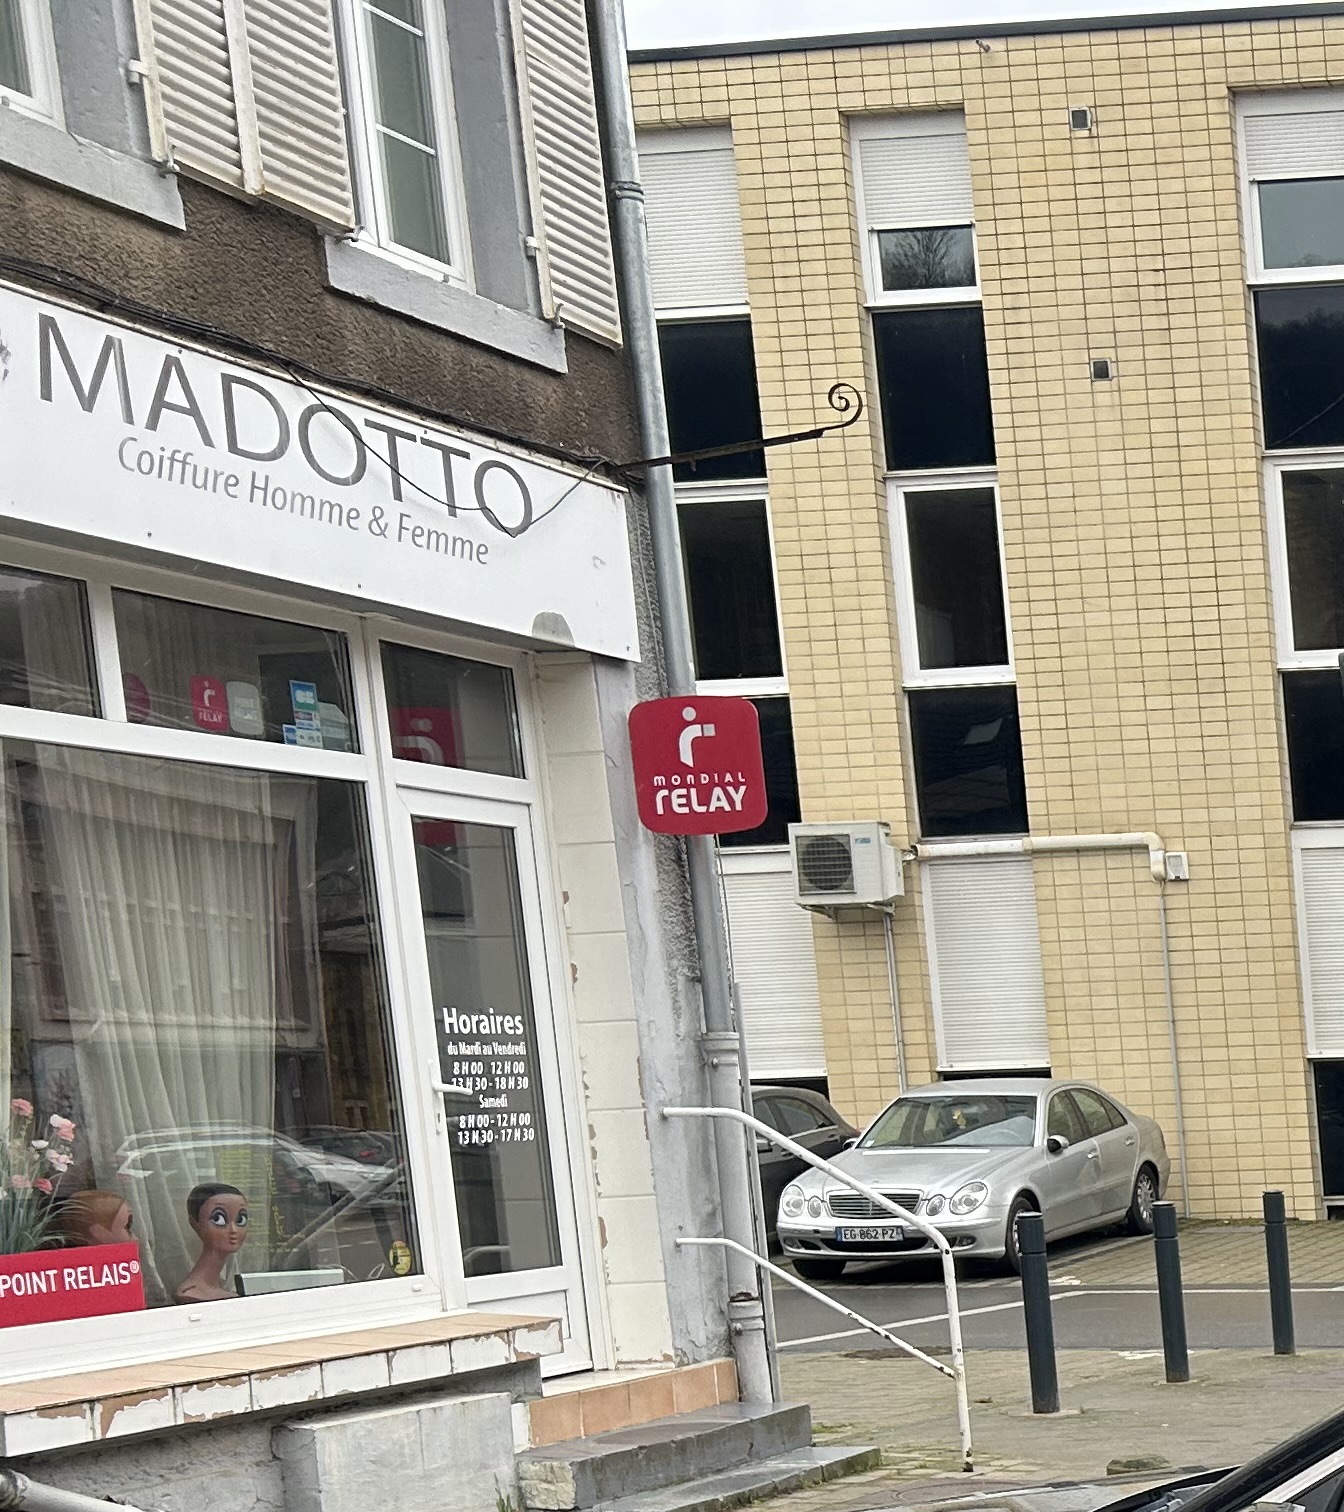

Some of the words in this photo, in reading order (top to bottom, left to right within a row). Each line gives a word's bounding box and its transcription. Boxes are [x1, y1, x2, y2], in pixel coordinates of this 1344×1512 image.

[38, 312, 533, 537] MADOTTO
[118, 436, 239, 499] Coiffure
[249, 470, 361, 530] Homme
[368, 506, 389, 539] &
[398, 512, 489, 565] Femme
[443, 1007, 524, 1035] Horaires
[479, 1093, 508, 1108] Samedi
[0, 1269, 58, 1298] POINT
